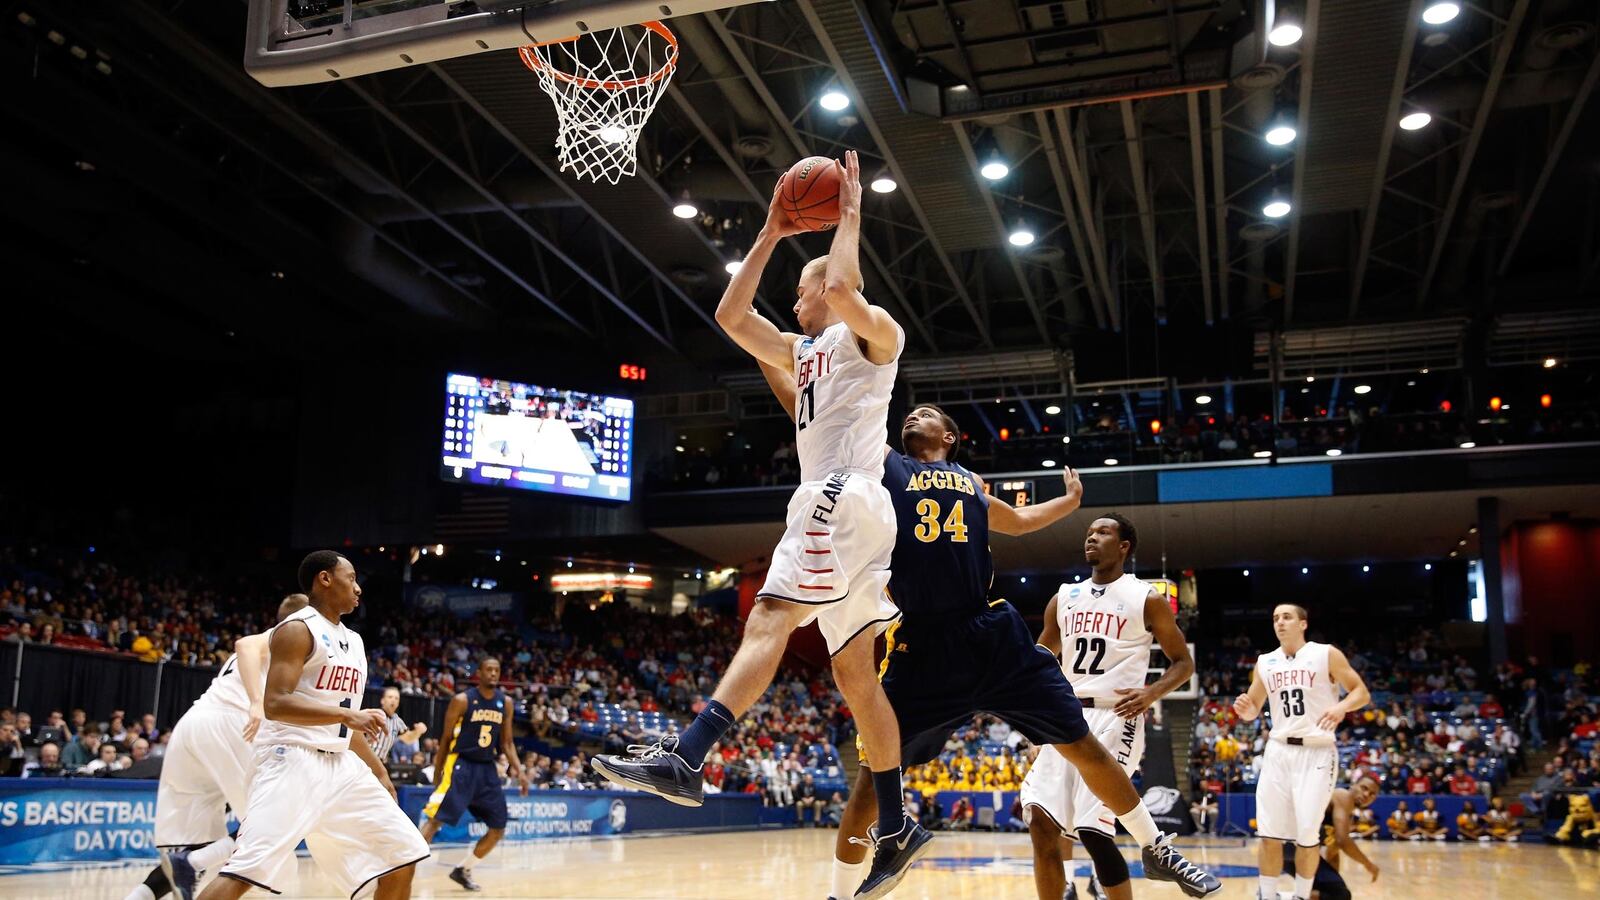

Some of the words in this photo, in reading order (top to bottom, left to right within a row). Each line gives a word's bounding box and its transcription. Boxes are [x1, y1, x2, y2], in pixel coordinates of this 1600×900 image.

[799, 381, 815, 432] 21
[906, 470, 975, 496] AGGIES
[914, 499, 968, 543] 34
[1065, 612, 1128, 639] LIBERTY
[1073, 638, 1106, 674] 22
[1267, 670, 1316, 693] LIBERTY
[1280, 689, 1305, 717] 33
[337, 697, 352, 739] 1
[478, 725, 492, 748] 5
[533, 802, 568, 818] ROUND
